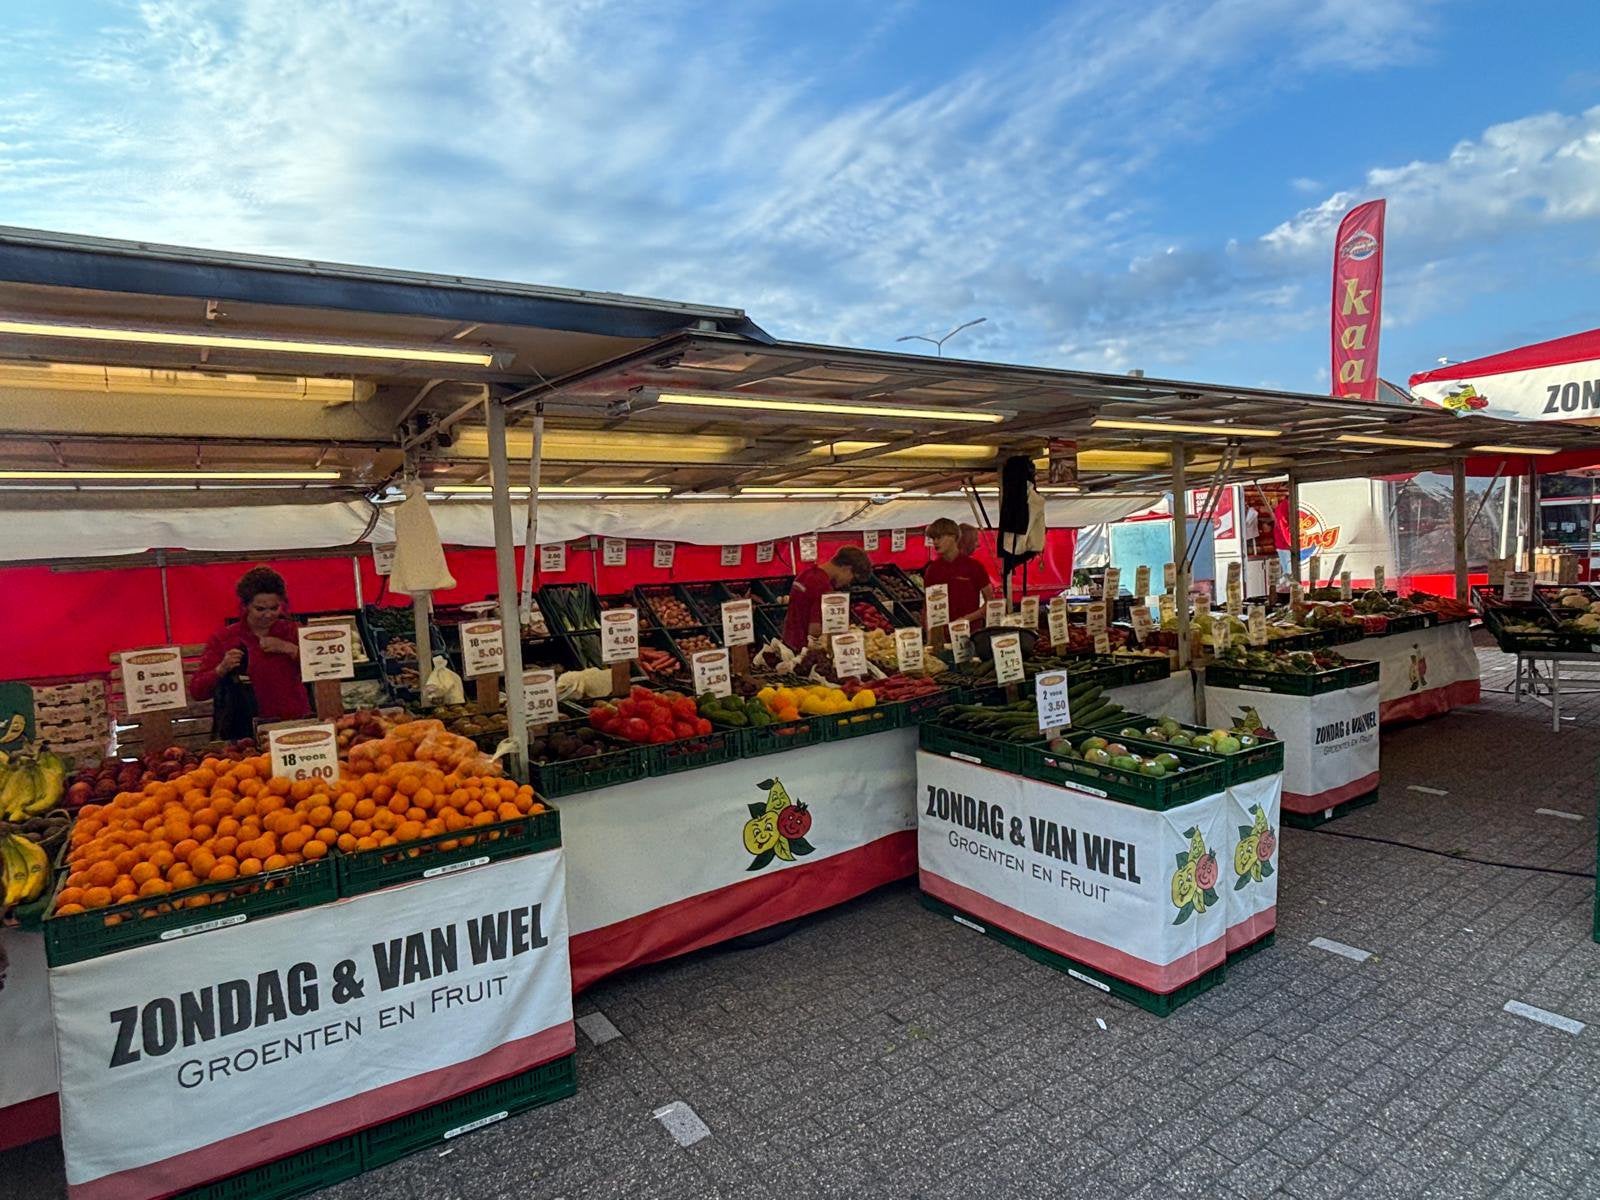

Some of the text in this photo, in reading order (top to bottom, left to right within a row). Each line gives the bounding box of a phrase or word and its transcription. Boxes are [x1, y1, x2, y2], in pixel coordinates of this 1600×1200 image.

[316, 643, 345, 656] 2.50
[478, 646, 503, 658] 5.00
[137, 670, 145, 681] 8
[144, 682, 178, 694] 5.00
[1043, 690, 1047, 700] 2
[527, 698, 553, 711] 3.50
[1048, 700, 1066, 712] 3.50
[1315, 720, 1345, 745] ZONDAG
[281, 753, 297, 767] 18
[295, 765, 333, 780] 6.00
[926, 784, 1141, 884] ZONDAG & VAN WEL
[108, 903, 549, 1069] ZONDAG & VAN WEL
